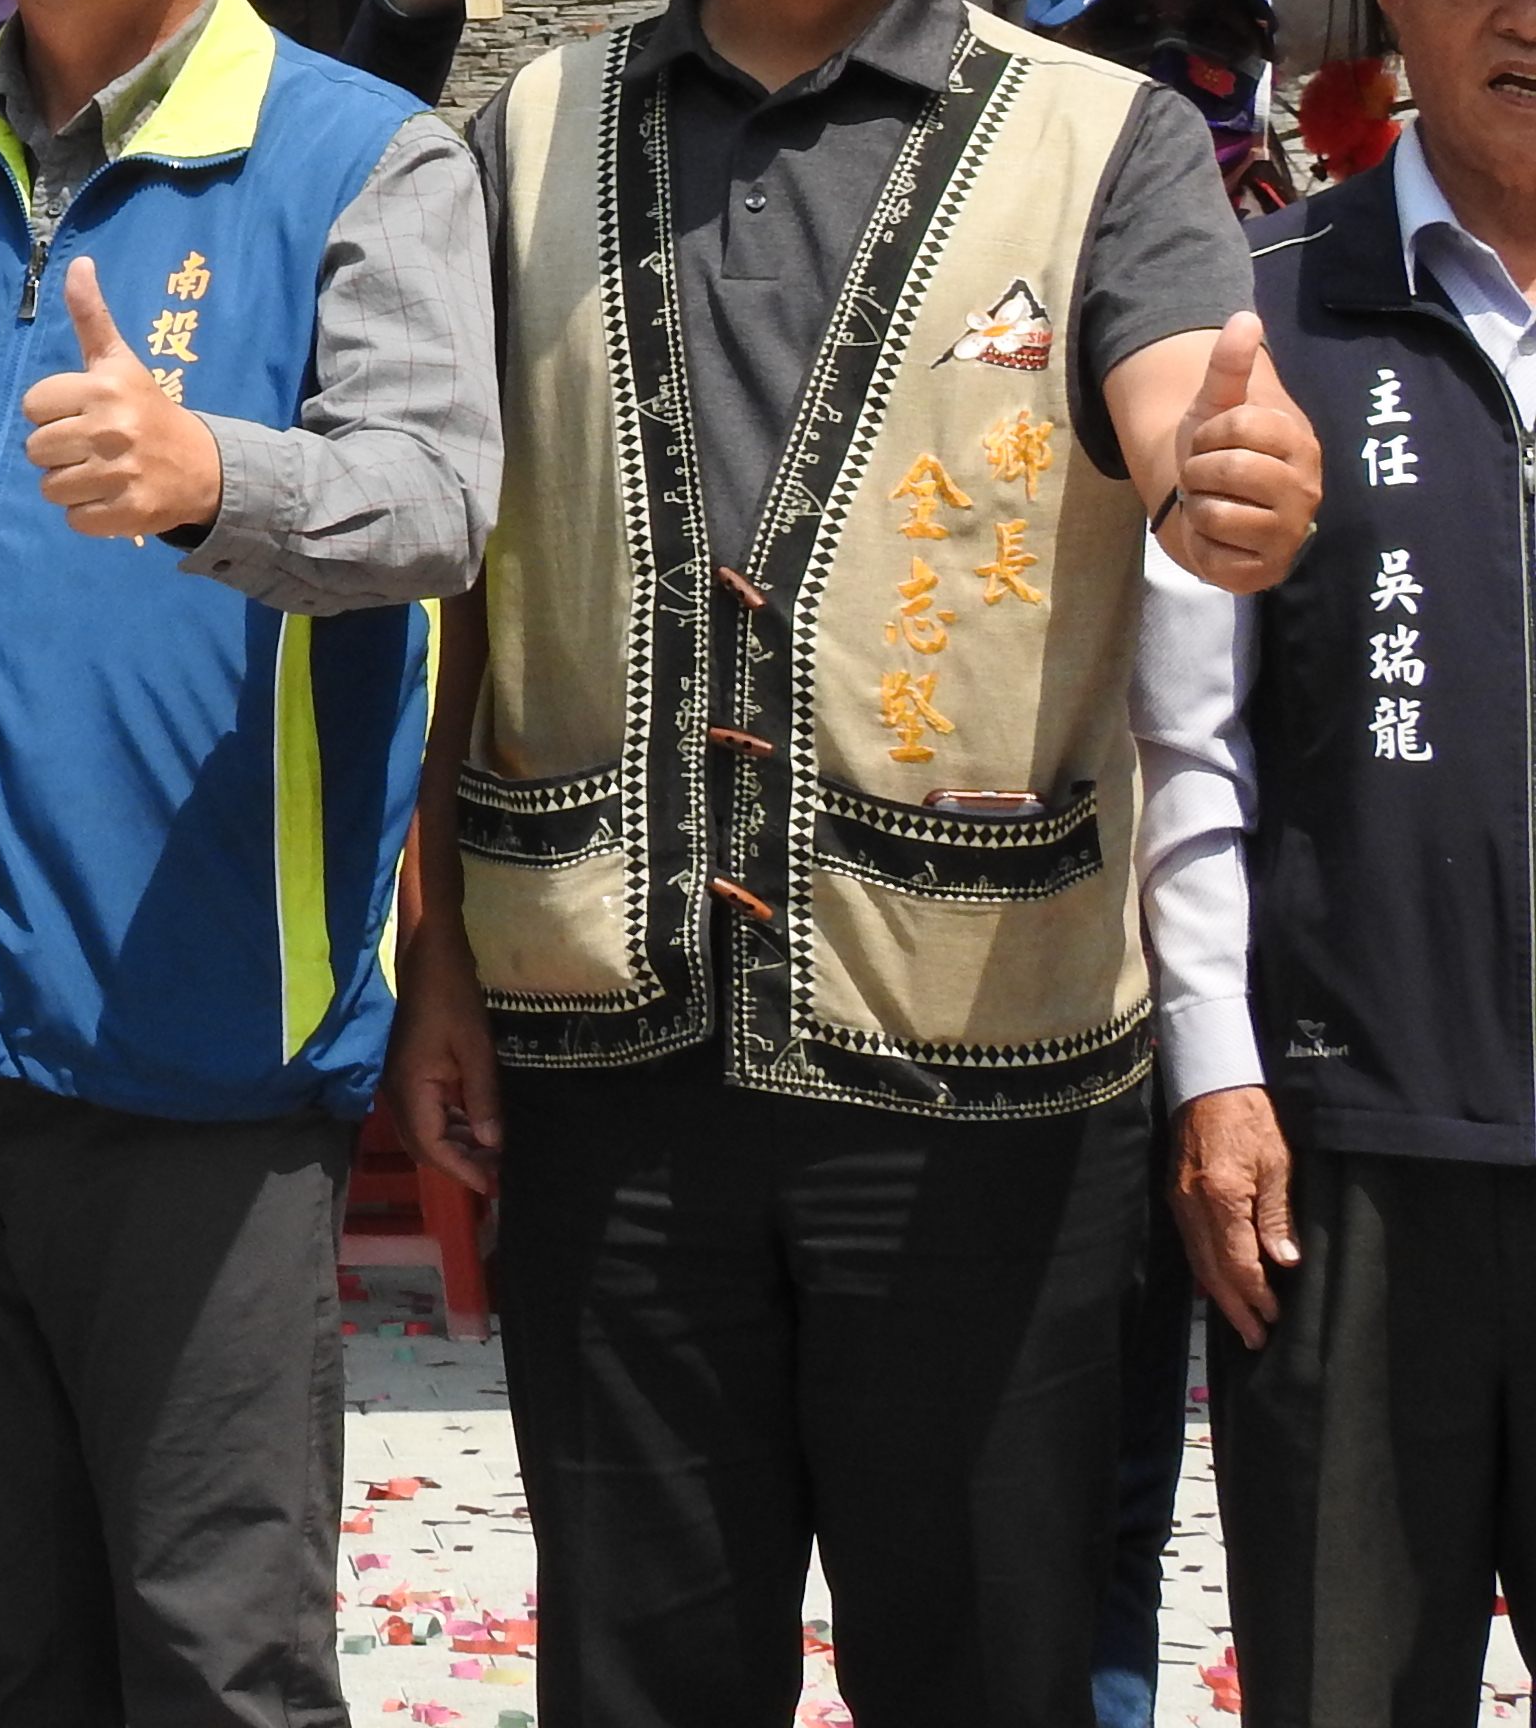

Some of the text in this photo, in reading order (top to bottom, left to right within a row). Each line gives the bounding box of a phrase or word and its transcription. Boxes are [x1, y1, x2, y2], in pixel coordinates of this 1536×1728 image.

[974, 409, 1055, 606] 鄉長
[1361, 367, 1419, 489] 主任
[879, 452, 975, 764] 全志堅
[1367, 547, 1434, 765] 吳瑞龍
